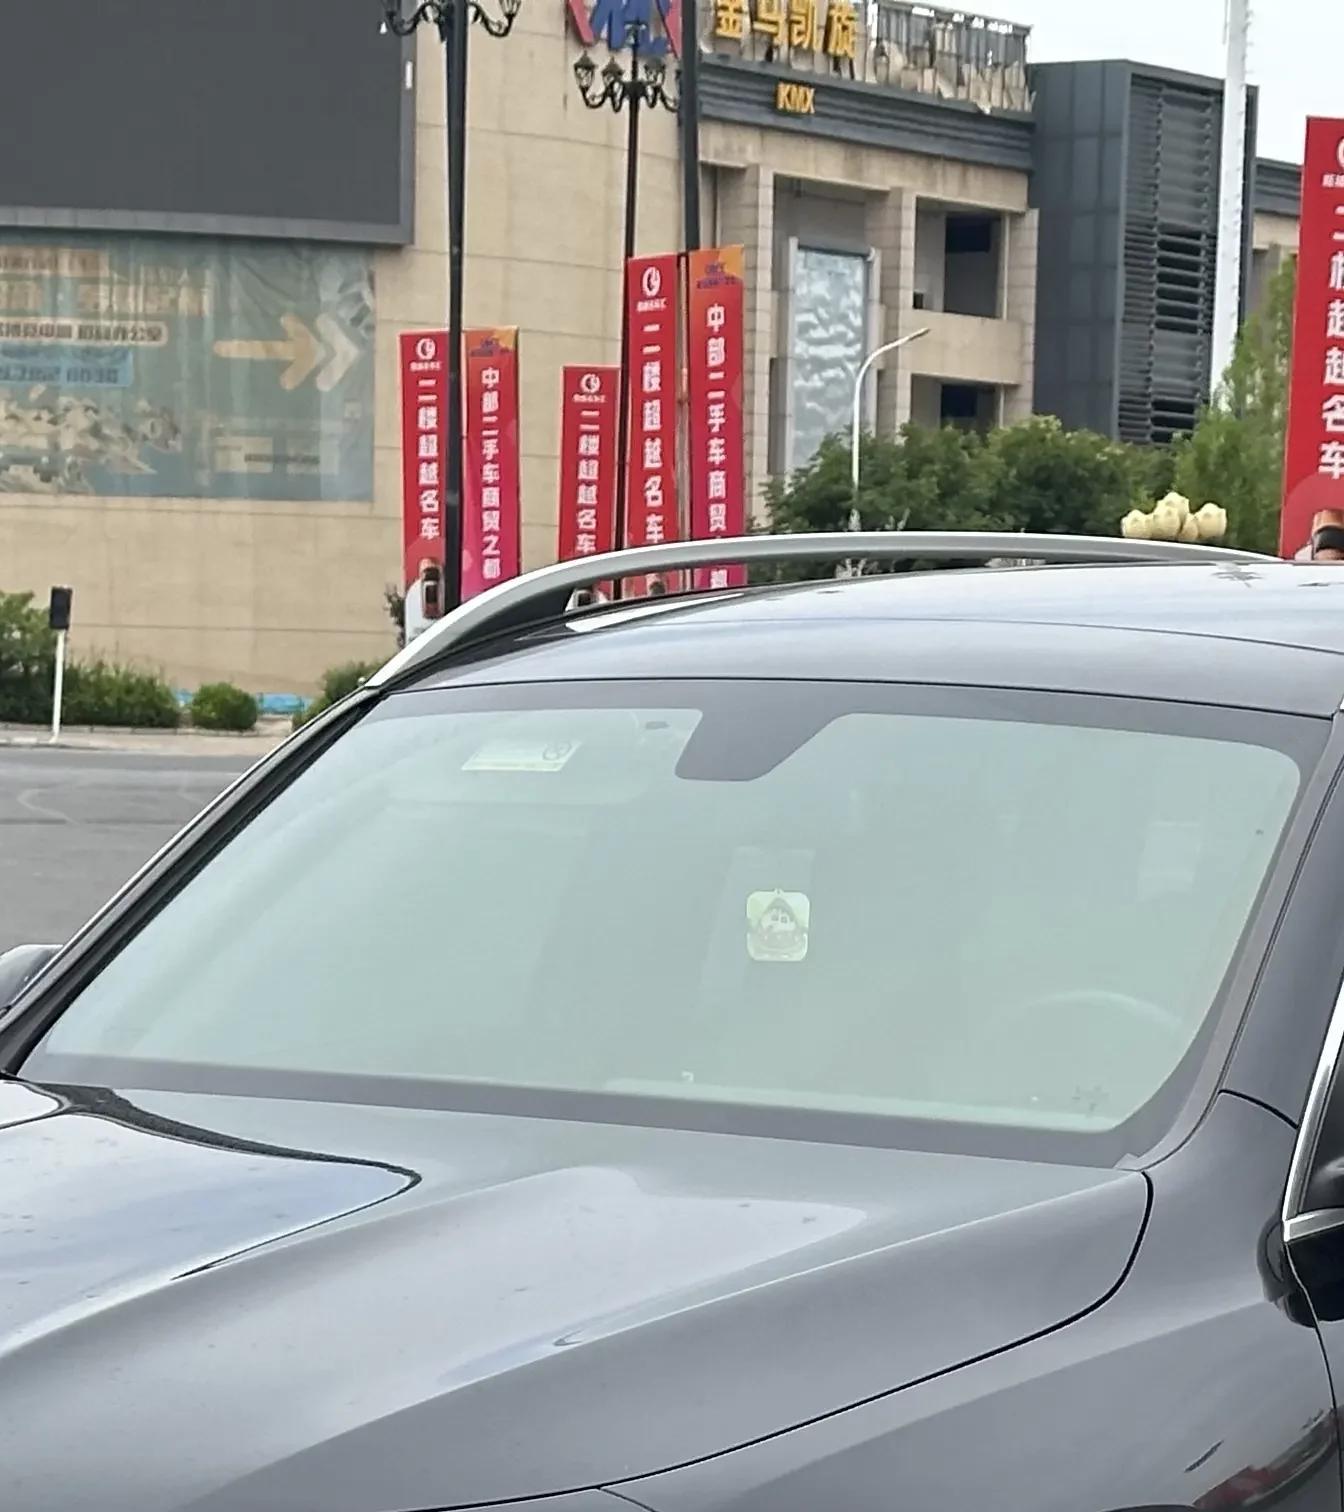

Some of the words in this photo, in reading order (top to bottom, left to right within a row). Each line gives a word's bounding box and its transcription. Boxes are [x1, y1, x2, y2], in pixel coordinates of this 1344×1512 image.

[777, 82, 816, 114] KMX
[417, 378, 440, 541] 二楼超越名车
[480, 366, 501, 580] 中部二手车商贸之都
[575, 410, 600, 553] 二楼超越名车
[642, 323, 665, 543] 二楼超越名车
[706, 303, 729, 589] 中部二手车商贸都
